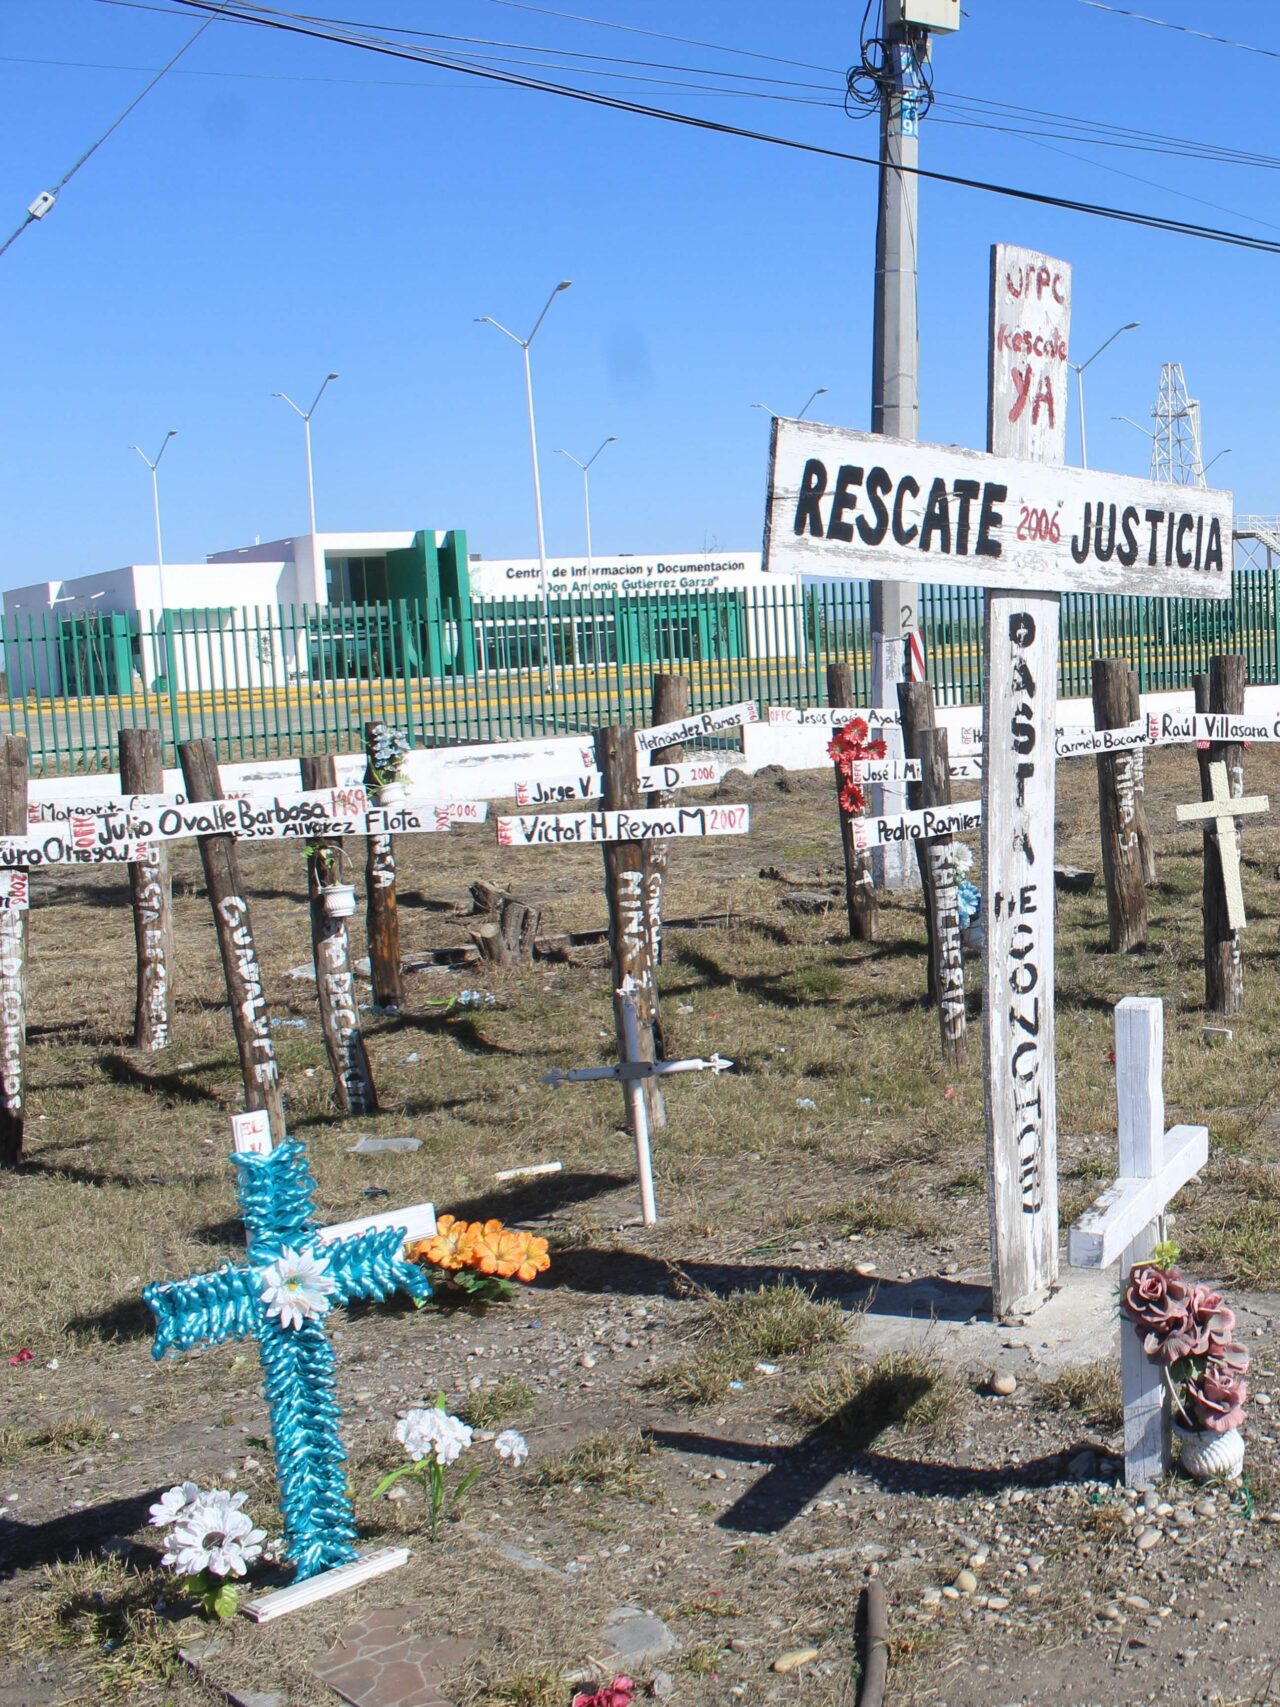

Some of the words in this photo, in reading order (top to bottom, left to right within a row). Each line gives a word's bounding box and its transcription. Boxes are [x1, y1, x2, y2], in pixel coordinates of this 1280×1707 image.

[1009, 364, 1055, 430] YA
[794, 458, 1008, 557] RESCATE
[1017, 505, 1062, 543] 2006
[1071, 502, 1224, 572] JUSTICIA
[506, 567, 549, 578] Centr
[552, 567, 568, 577] de
[647, 565, 653, 577] y
[1162, 712, 1198, 738] Raúl
[691, 767, 715, 781] 2006
[863, 763, 889, 782] José
[41, 799, 124, 822] Margarit
[97, 811, 153, 845] Julio
[238, 797, 329, 830] Barbosa
[365, 809, 422, 833] Flota
[449, 803, 478, 818] 2006
[617, 812, 676, 841] Reyna
[678, 808, 707, 837] M
[710, 807, 746, 831] 2007
[877, 819, 922, 844] Pedro
